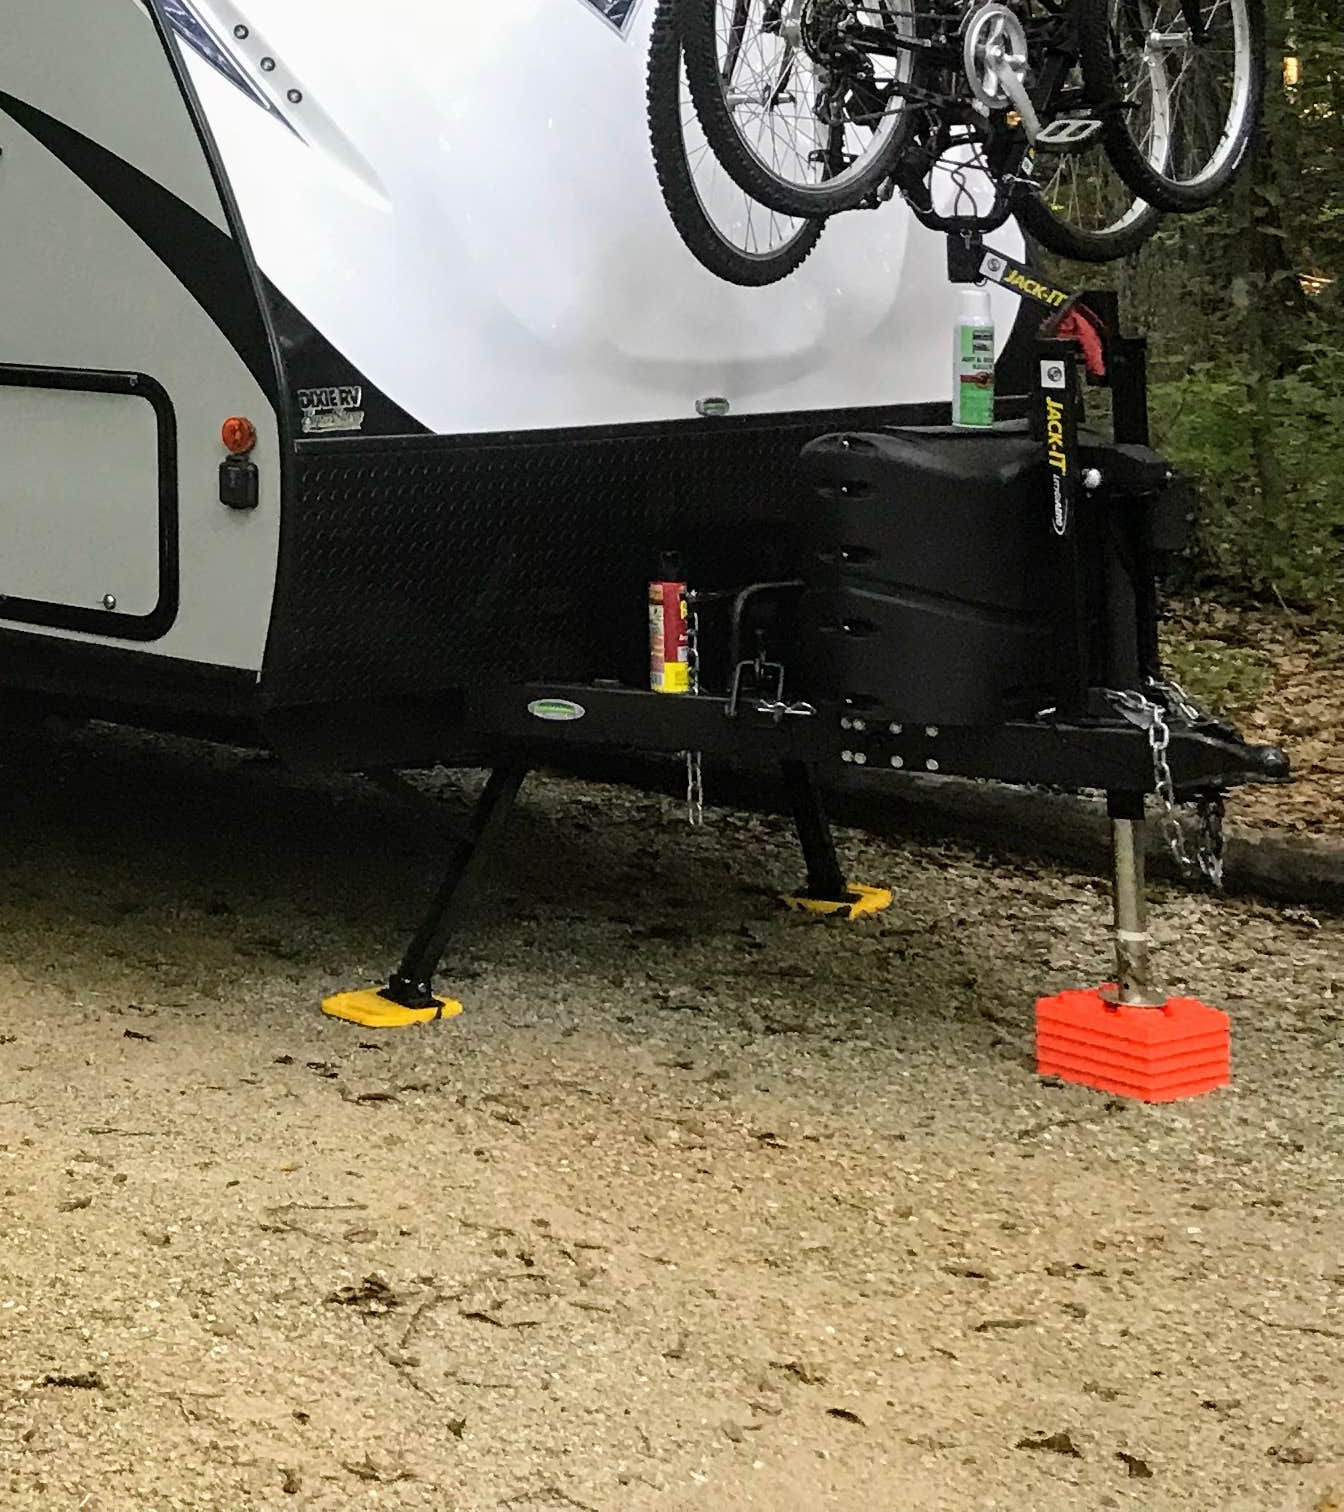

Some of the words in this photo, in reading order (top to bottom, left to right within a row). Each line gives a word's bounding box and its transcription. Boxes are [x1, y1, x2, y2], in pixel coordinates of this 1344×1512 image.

[1003, 269, 1069, 307] JACK-IT
[298, 388, 337, 408] DIXIE
[339, 386, 361, 407] RV
[1045, 395, 1068, 476] JACK-IT
